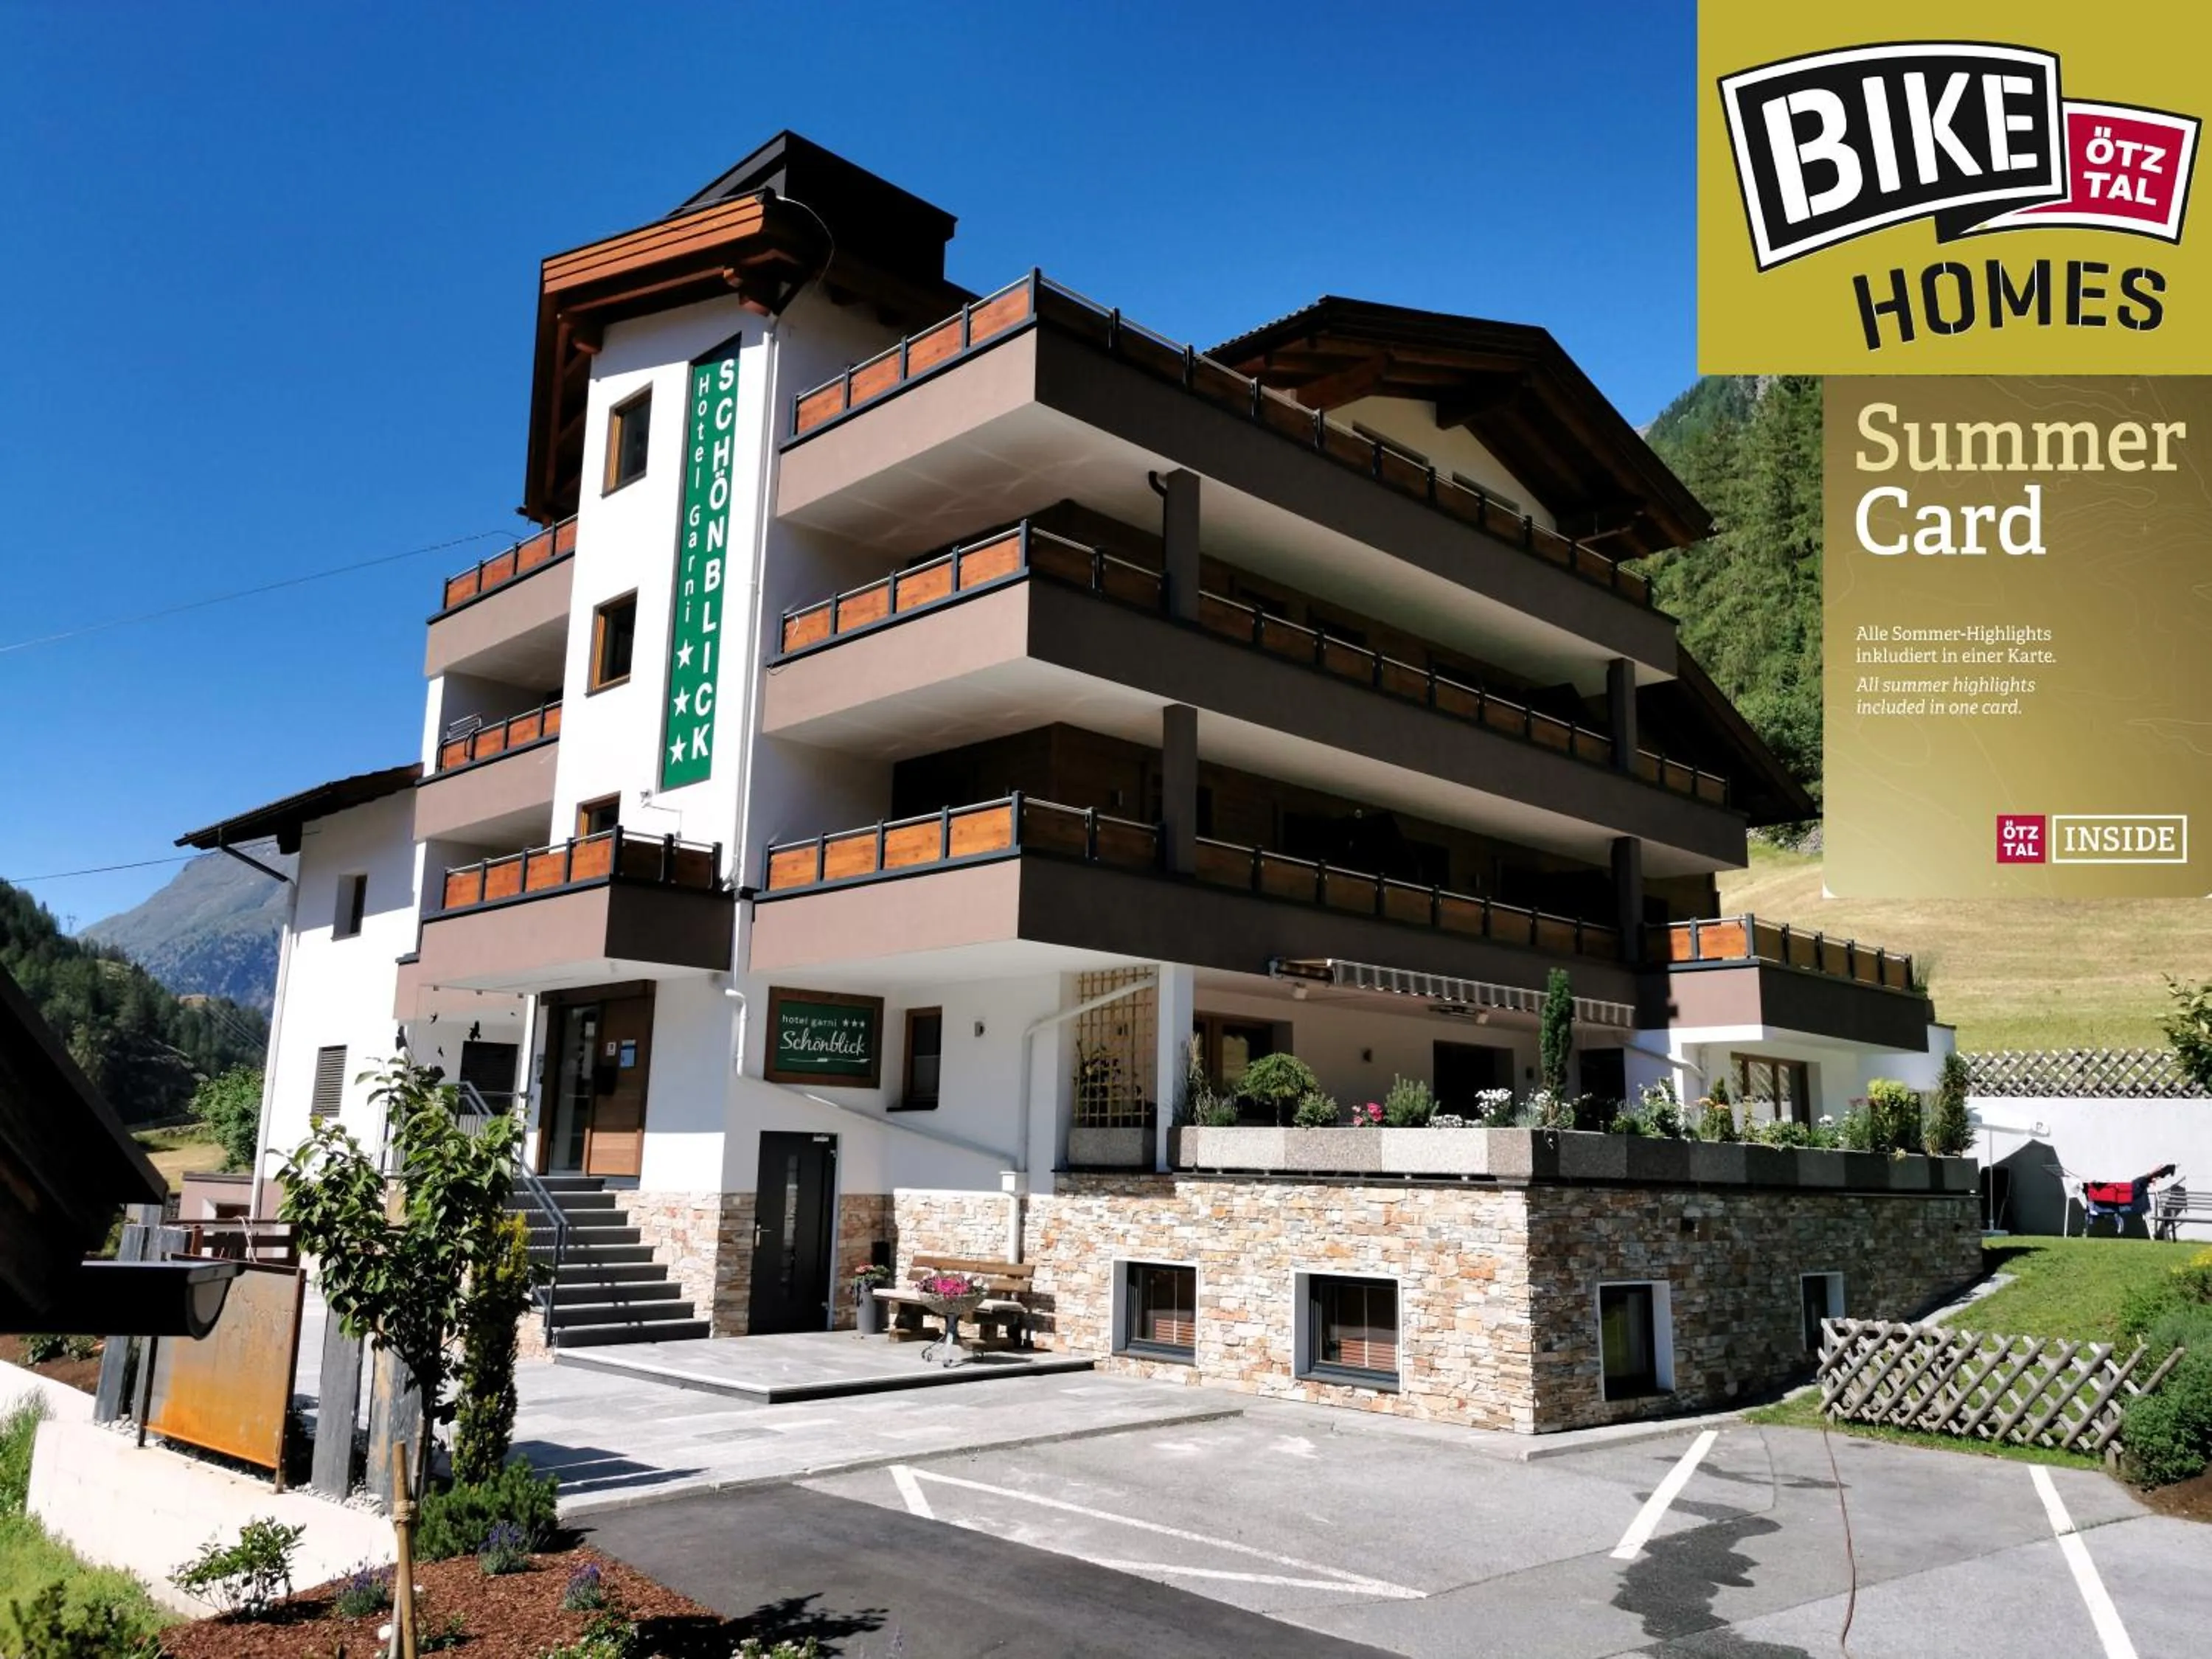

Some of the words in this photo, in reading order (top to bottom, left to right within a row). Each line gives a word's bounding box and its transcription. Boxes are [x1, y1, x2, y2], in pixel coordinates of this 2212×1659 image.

[695, 372, 710, 490] Hotel
[684, 504, 701, 624] Garni
[691, 358, 734, 760] SCHÖNBLICK
[779, 1027, 865, 1056] Schönblick
[782, 1014, 808, 1025] hotel
[811, 1017, 837, 1028] garni
